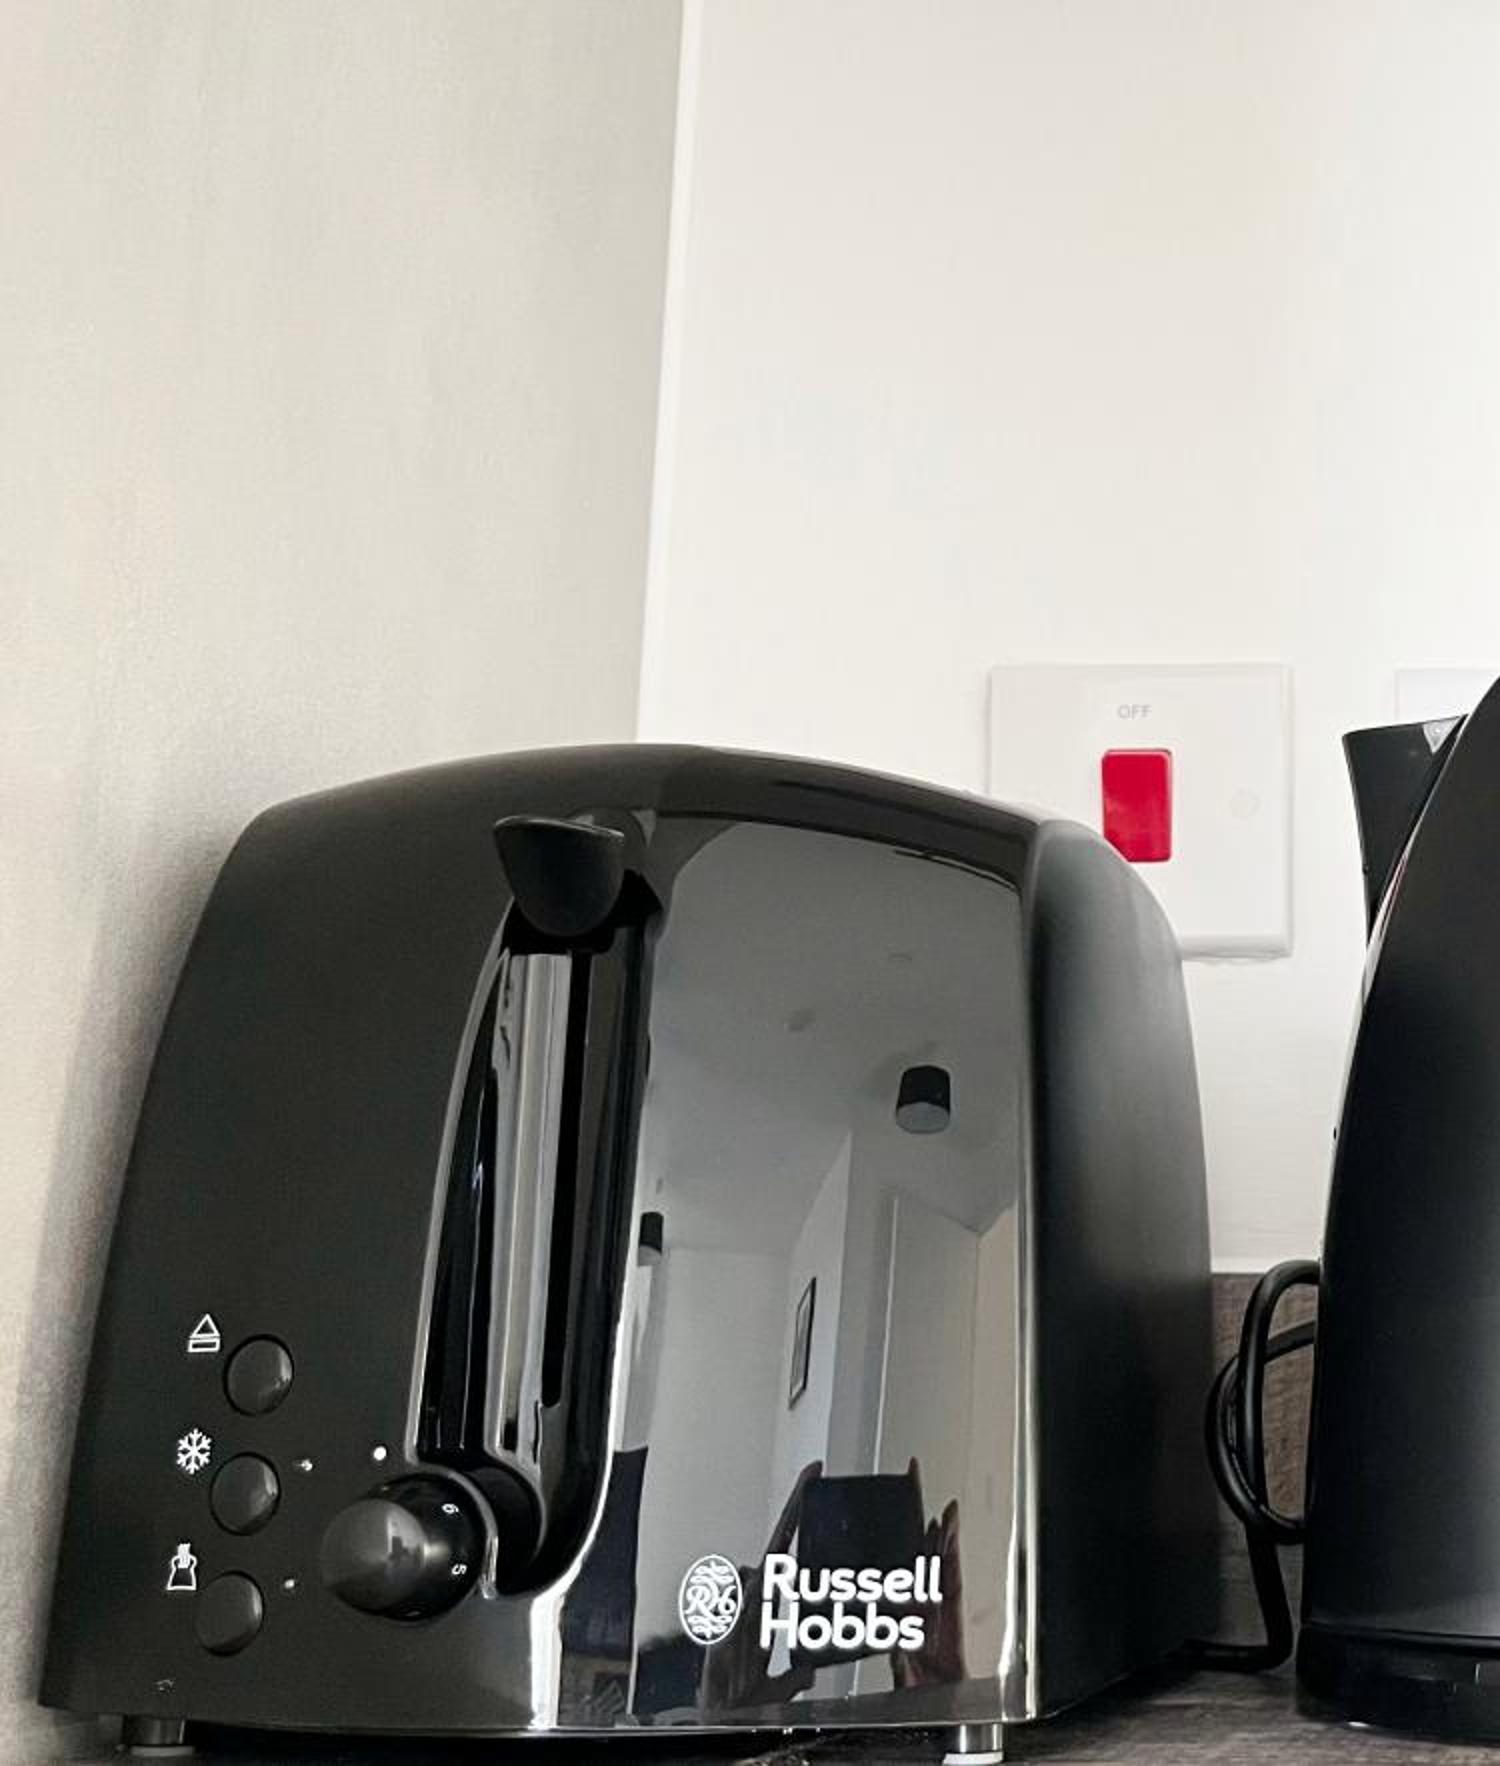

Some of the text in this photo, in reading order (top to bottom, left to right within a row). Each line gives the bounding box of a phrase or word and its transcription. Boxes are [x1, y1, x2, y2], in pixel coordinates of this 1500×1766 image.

[1117, 704, 1152, 720] OFF
[762, 1553, 943, 1603] Russell
[759, 1600, 926, 1650] Hobbs
